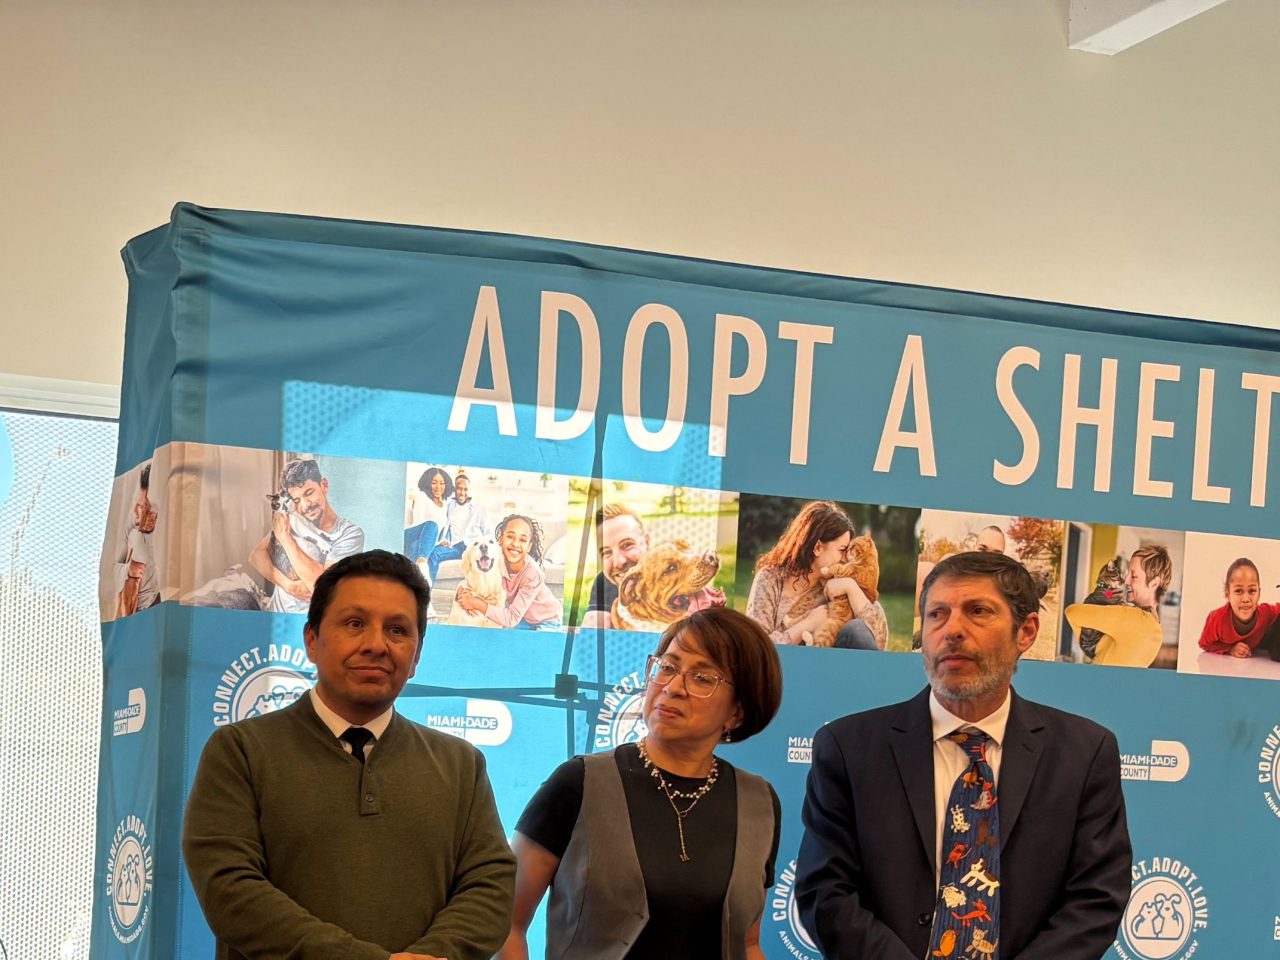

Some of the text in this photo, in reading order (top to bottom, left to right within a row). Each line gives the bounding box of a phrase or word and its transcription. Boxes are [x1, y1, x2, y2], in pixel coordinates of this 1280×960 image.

[446, 284, 835, 468] ADOPT
[872, 333, 938, 478] A
[427, 714, 497, 729] MIAMI-DADE
